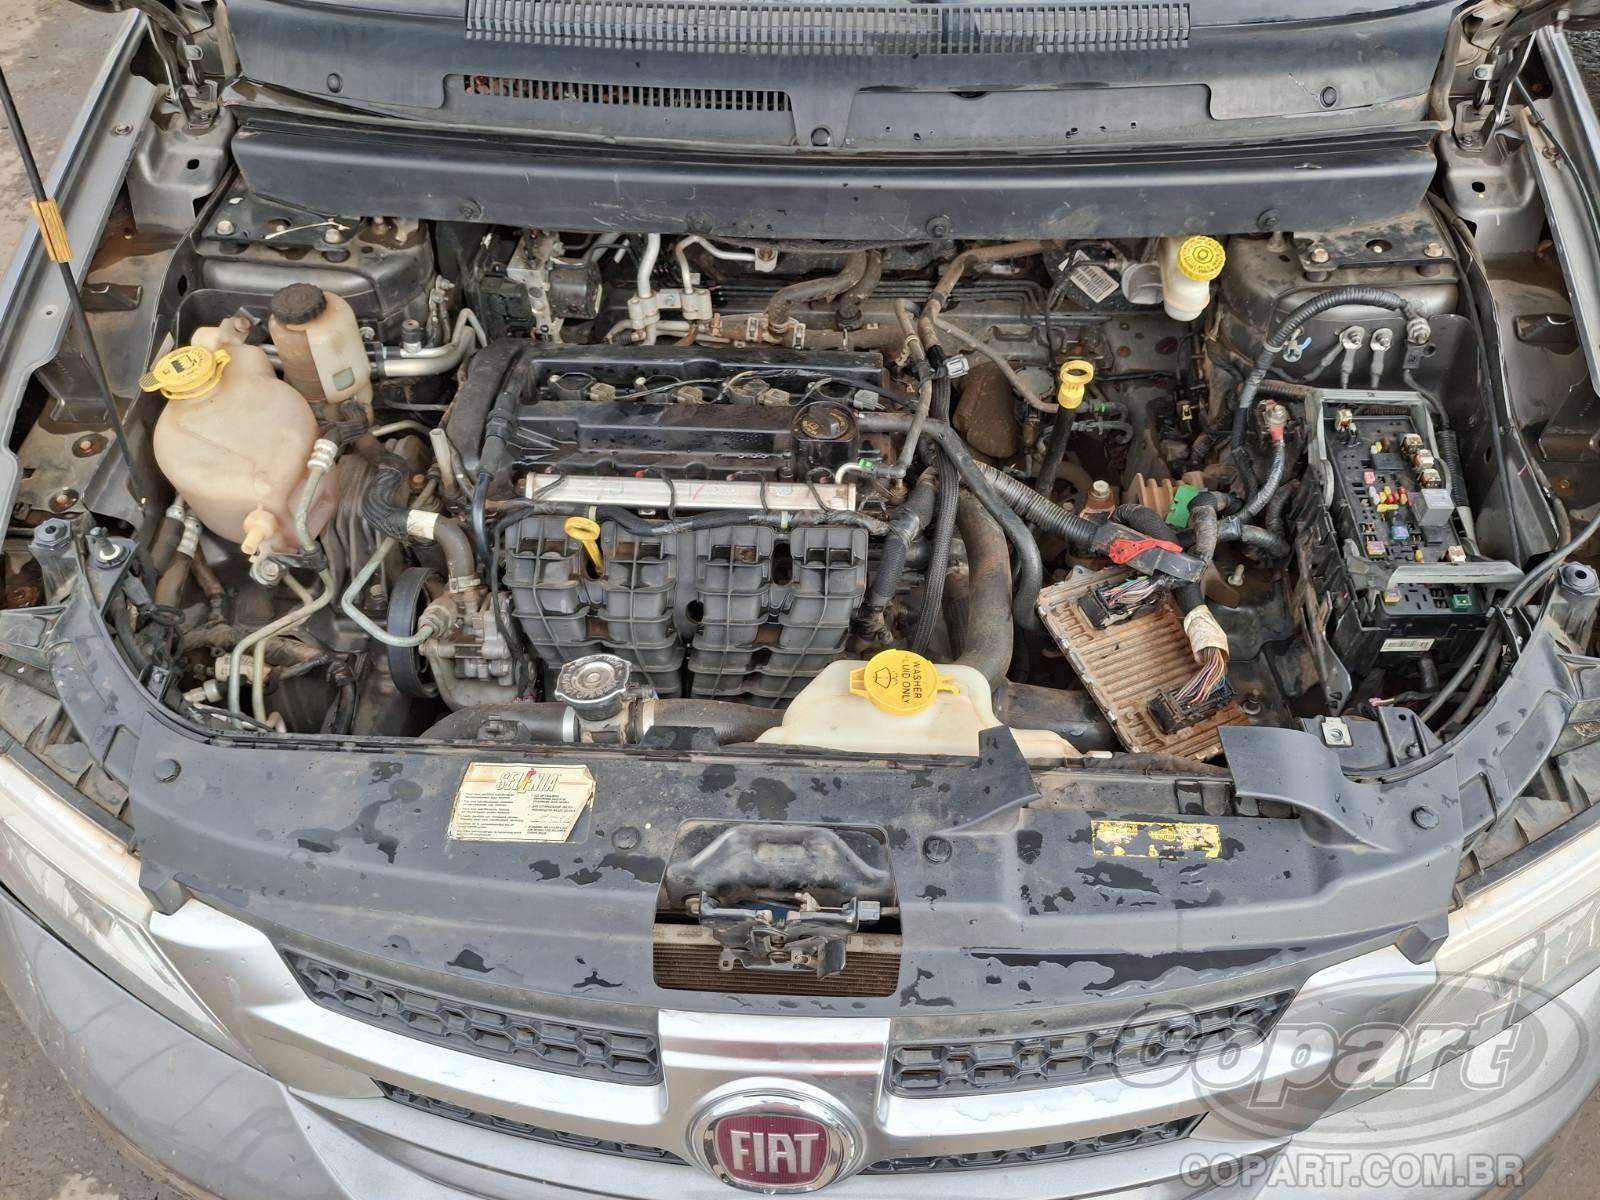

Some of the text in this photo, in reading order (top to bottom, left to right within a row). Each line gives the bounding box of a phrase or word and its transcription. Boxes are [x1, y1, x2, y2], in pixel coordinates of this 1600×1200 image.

[901, 681, 911, 704] ONLY
[912, 661, 922, 699] WASHER
[730, 1130, 819, 1174] FIAT
